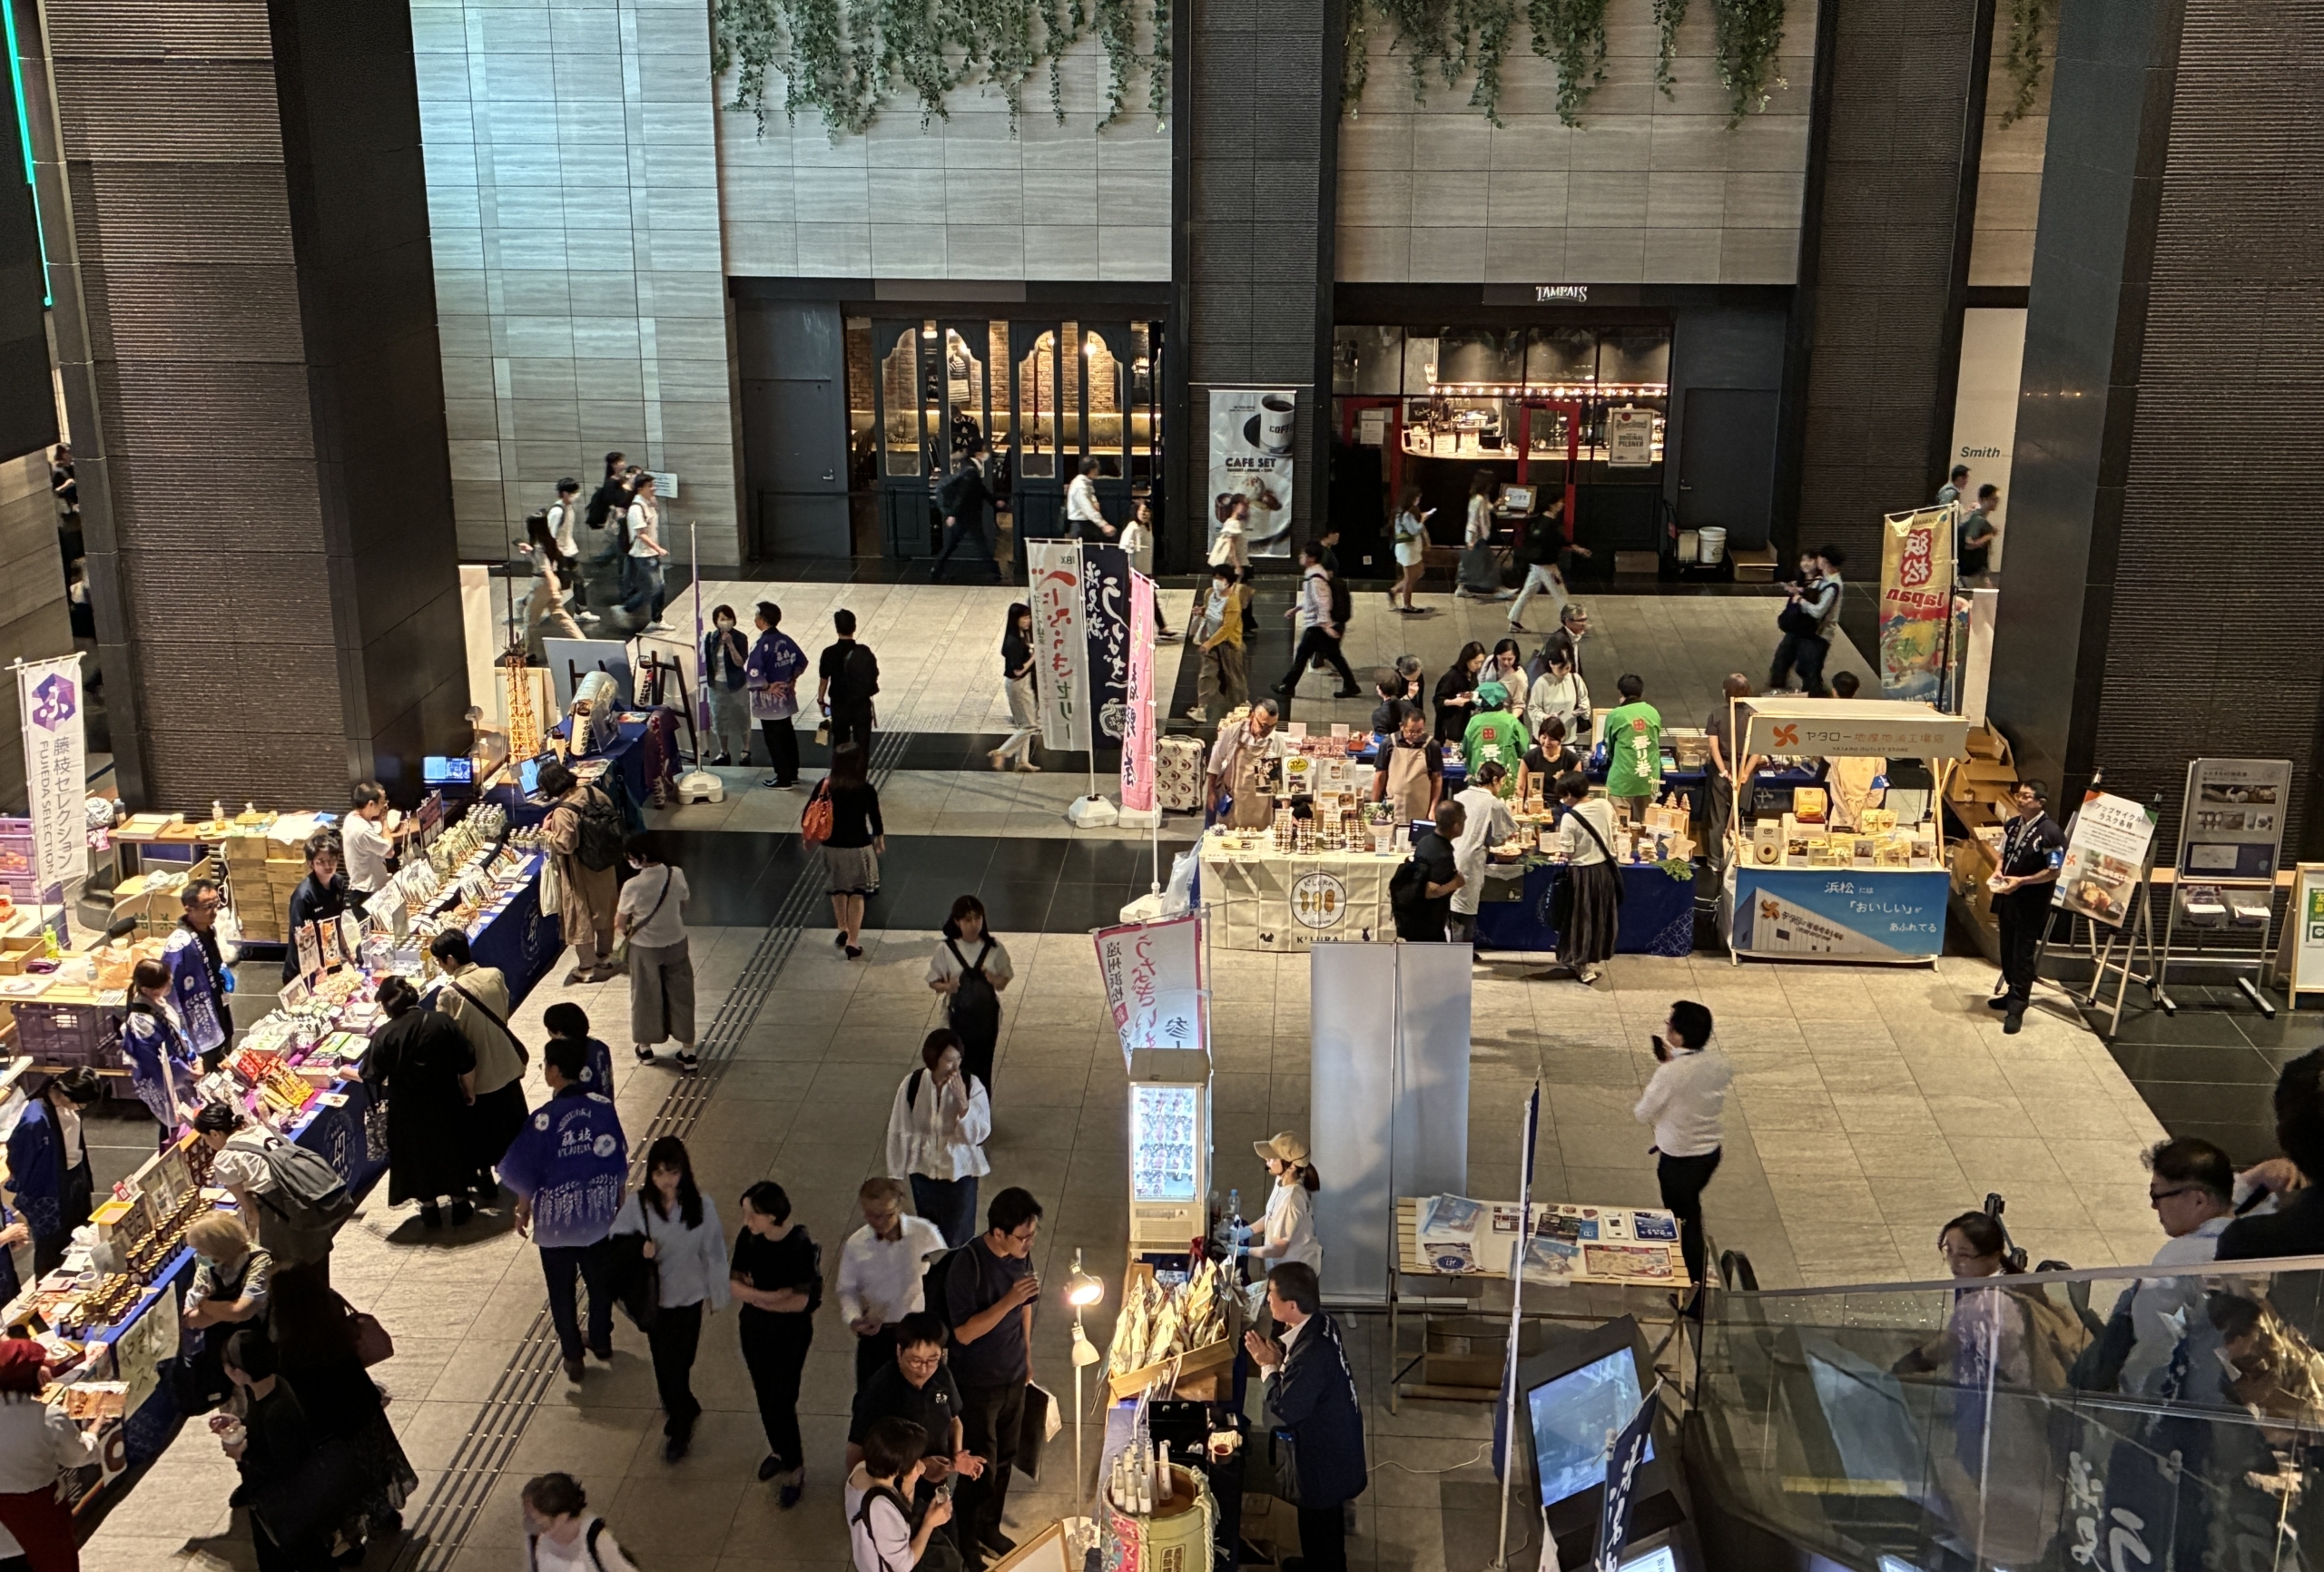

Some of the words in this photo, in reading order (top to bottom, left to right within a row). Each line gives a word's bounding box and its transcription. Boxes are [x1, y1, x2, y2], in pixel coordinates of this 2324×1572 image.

[1961, 447, 2001, 458] Smith
[1226, 457, 1255, 467] CAFE
[1258, 457, 1276, 467] SET
[40, 741, 51, 799] FUJIEDA
[53, 736, 74, 870] 藤枝セレクション
[2095, 802, 2142, 823] アップサイクル
[2099, 812, 2133, 830] ラスク各種
[42, 800, 54, 874] SELECTION
[1825, 881, 1855, 894] 浜松
[1889, 923, 1937, 933] あふれてる
